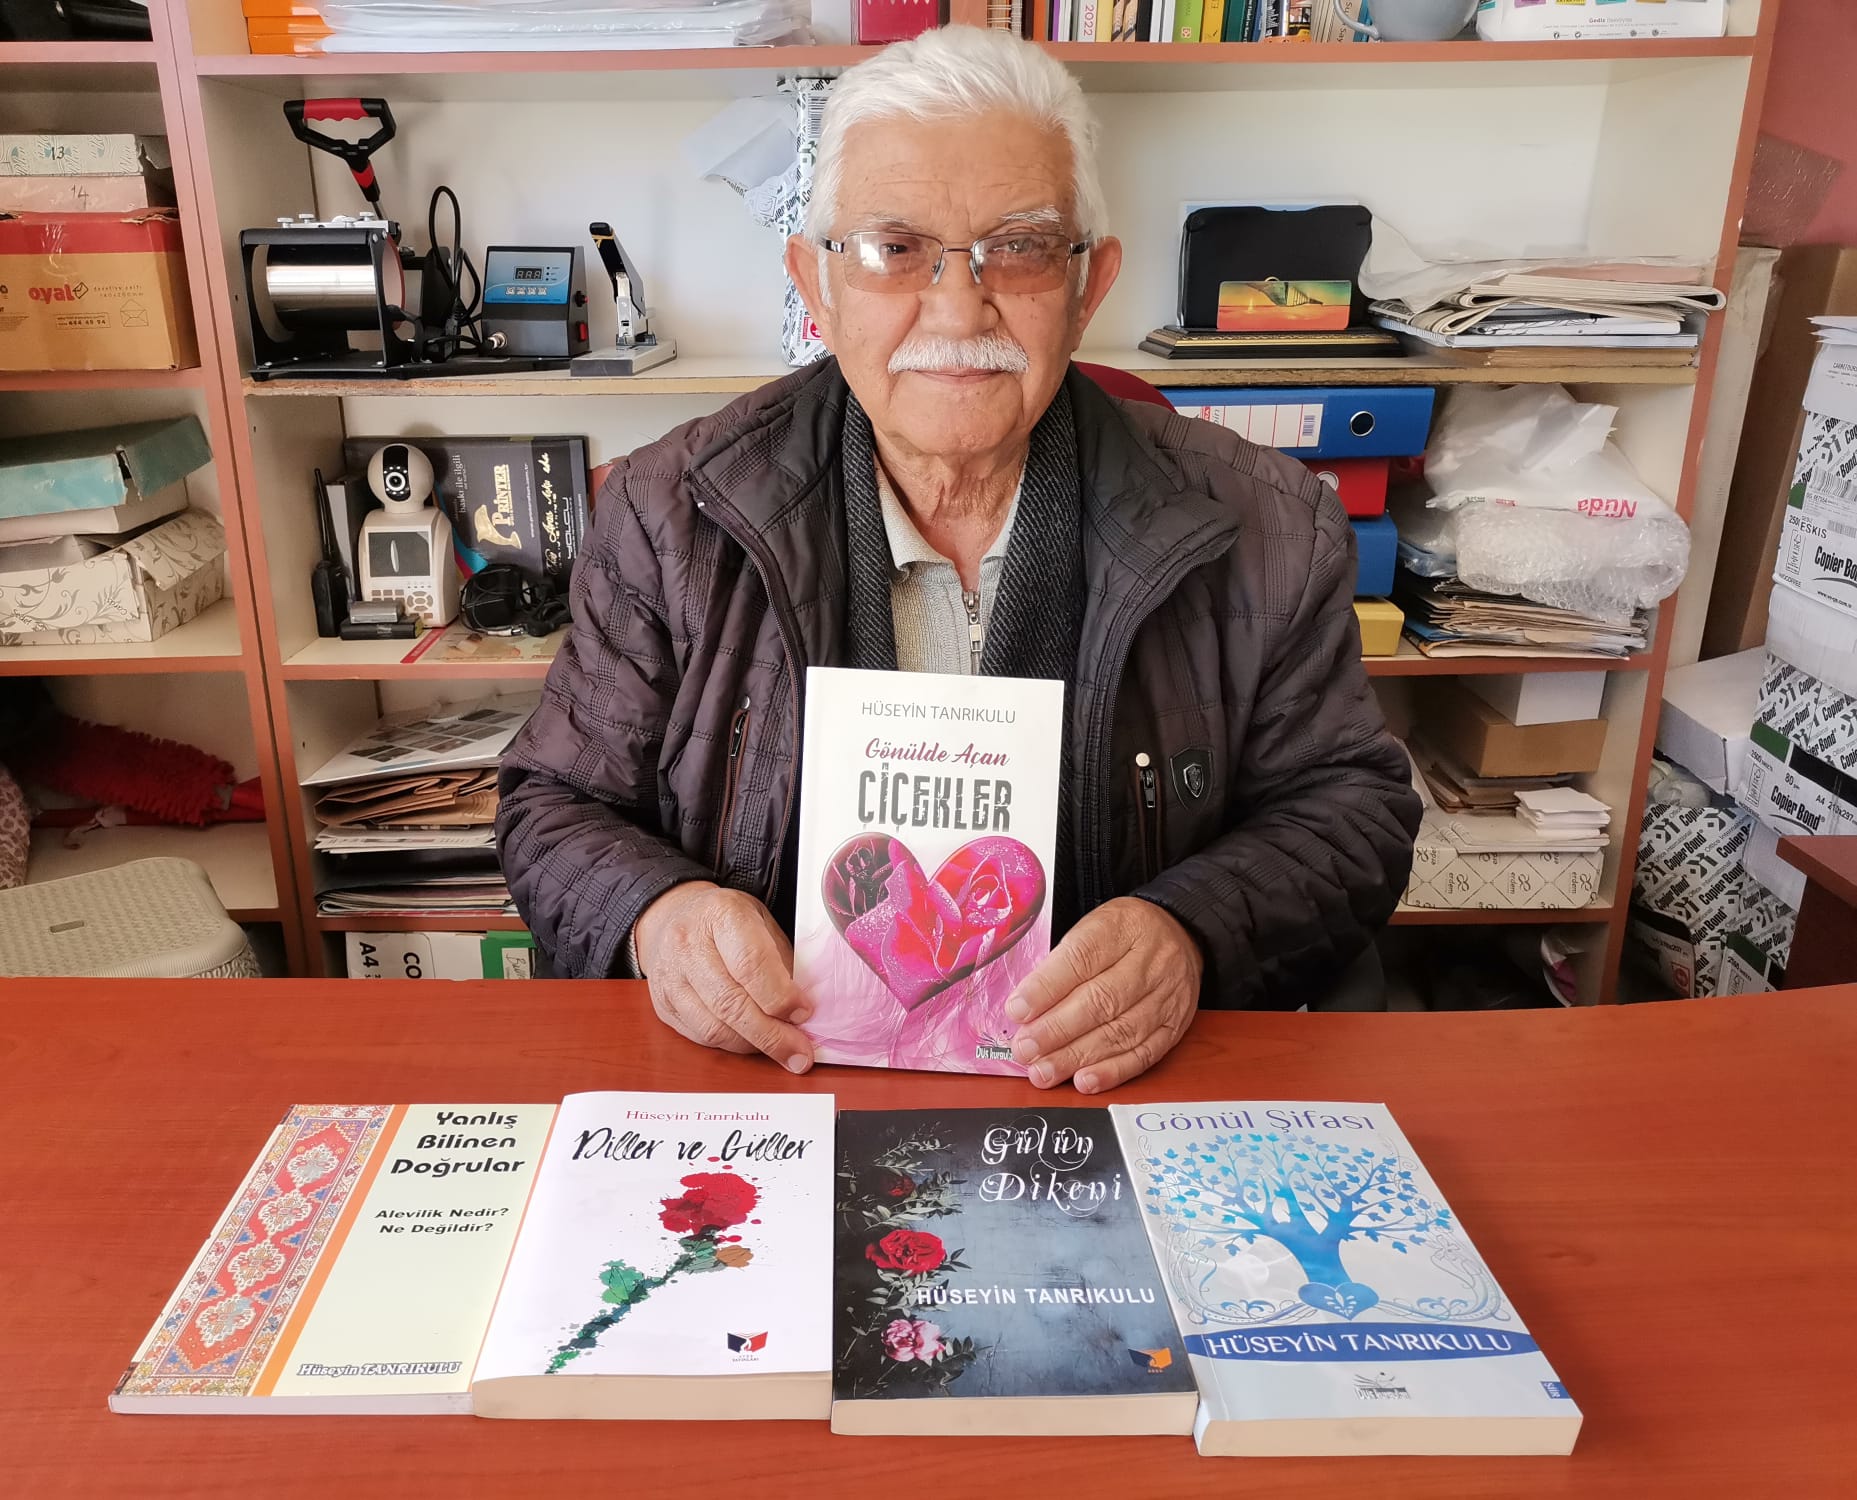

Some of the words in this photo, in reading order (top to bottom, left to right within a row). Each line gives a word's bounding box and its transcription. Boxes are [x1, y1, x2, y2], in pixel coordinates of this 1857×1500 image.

[1084, 5, 1095, 36] 2022
[51, 147, 65, 160] 13
[70, 184, 89, 211] 14
[28, 283, 76, 304] oyal
[1800, 521, 1828, 539] ESKIS
[1815, 546, 1845, 574] Copier
[1844, 558, 1857, 581] Bo
[861, 700, 926, 719] HÜSEYİN
[930, 706, 1016, 724] TANRIKULU
[1821, 697, 1846, 722] Copier
[865, 738, 950, 762] Gönülde
[951, 743, 1010, 768] Açan
[1818, 731, 1837, 753] Bond
[858, 762, 1012, 833] ÇİÇEKLER
[1770, 785, 1799, 816] Copier
[1816, 794, 1826, 806] A4
[1716, 831, 1746, 859] Copier
[1663, 847, 1689, 871] Copier
[1698, 877, 1727, 906] Copier
[359, 942, 379, 969] A4
[436, 1111, 518, 1130] Yanlış
[626, 1110, 689, 1122] Hüseyin
[695, 1111, 770, 1122] Tanrıkulu
[1135, 1110, 1255, 1132] Gönül
[1265, 1109, 1375, 1133] Şifası
[416, 1134, 516, 1149] Bilinen
[572, 1127, 665, 1161] Diller
[677, 1139, 707, 1160] ve
[720, 1129, 814, 1162] Güller
[981, 1116, 1094, 1168] Gülün
[390, 1157, 526, 1178] Doğrular
[979, 1167, 1122, 1215] Dikeni
[375, 1209, 443, 1219] Alevilik
[449, 1208, 509, 1218] Nedir?
[379, 1225, 405, 1233] Ne
[411, 1223, 494, 1235] Değildir?
[917, 1285, 1016, 1305] HÜSEYİN
[1024, 1288, 1156, 1305] TANRIKULU
[1205, 1332, 1337, 1355] HÜSEYİN
[1341, 1333, 1512, 1352] TANRIKULU
[297, 1362, 360, 1378] Hüseyin
[360, 1361, 462, 1376] TANRIKULU
